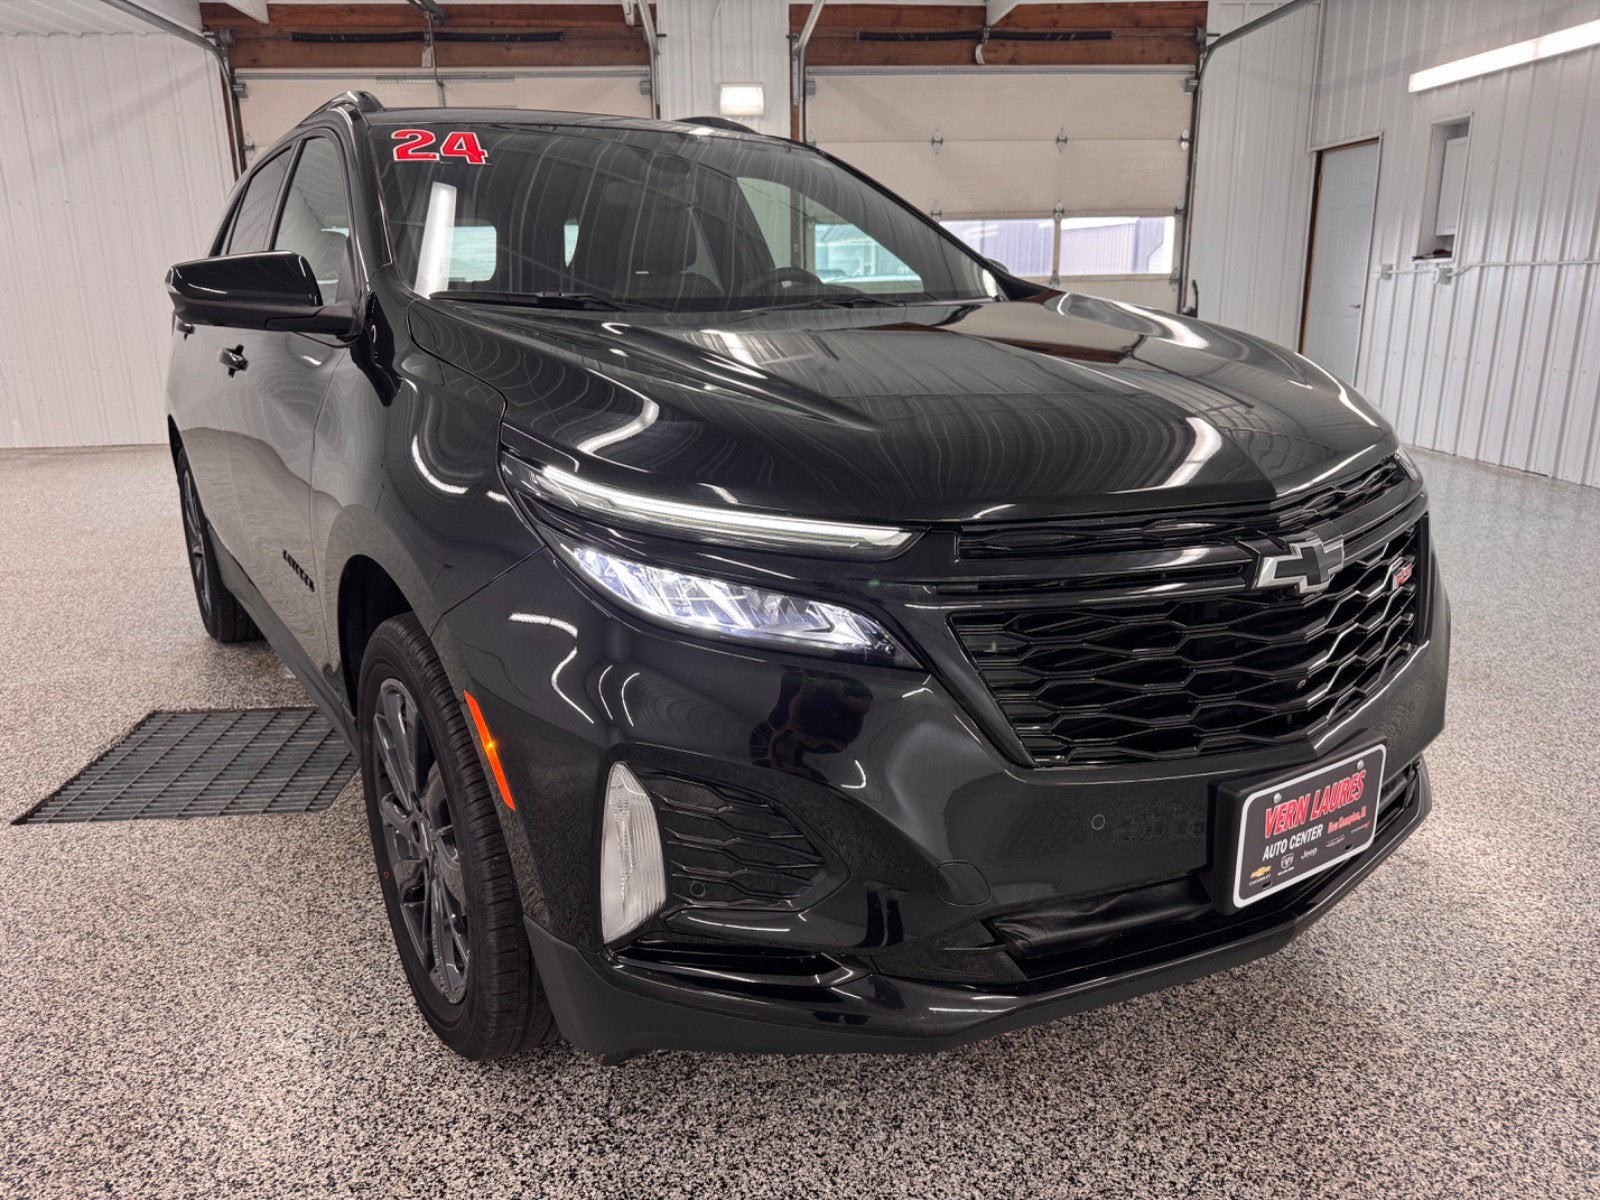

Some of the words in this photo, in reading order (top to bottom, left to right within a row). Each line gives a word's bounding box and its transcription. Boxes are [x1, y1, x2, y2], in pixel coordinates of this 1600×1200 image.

[391, 128, 488, 165] 24
[1265, 793, 1311, 838] VERN
[1310, 769, 1366, 821] LAURES
[1262, 838, 1288, 861] AUTO
[1289, 823, 1323, 850] CENTER
